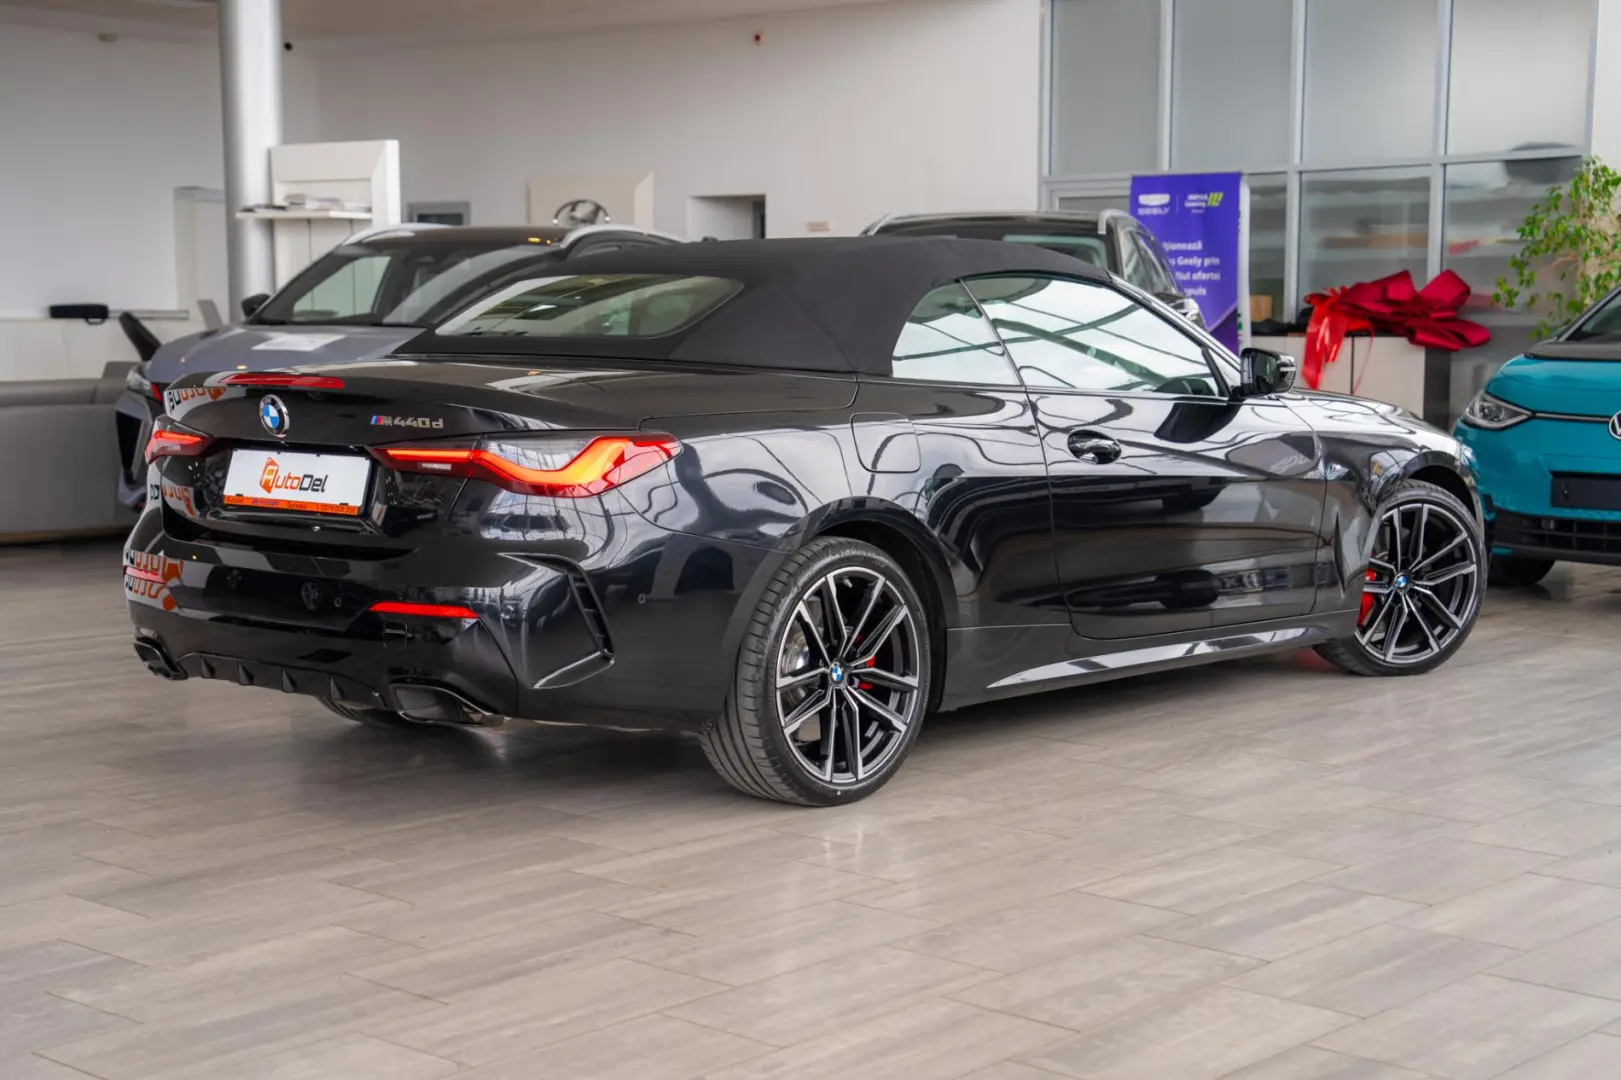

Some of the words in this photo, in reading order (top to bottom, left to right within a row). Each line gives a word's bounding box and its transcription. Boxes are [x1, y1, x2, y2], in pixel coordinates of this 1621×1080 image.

[1137, 207, 1169, 215] GEELY
[1177, 256, 1202, 267] Geely
[1203, 256, 1220, 267] prin
[371, 415, 444, 428] M440d
[259, 457, 328, 493] AutoDel
